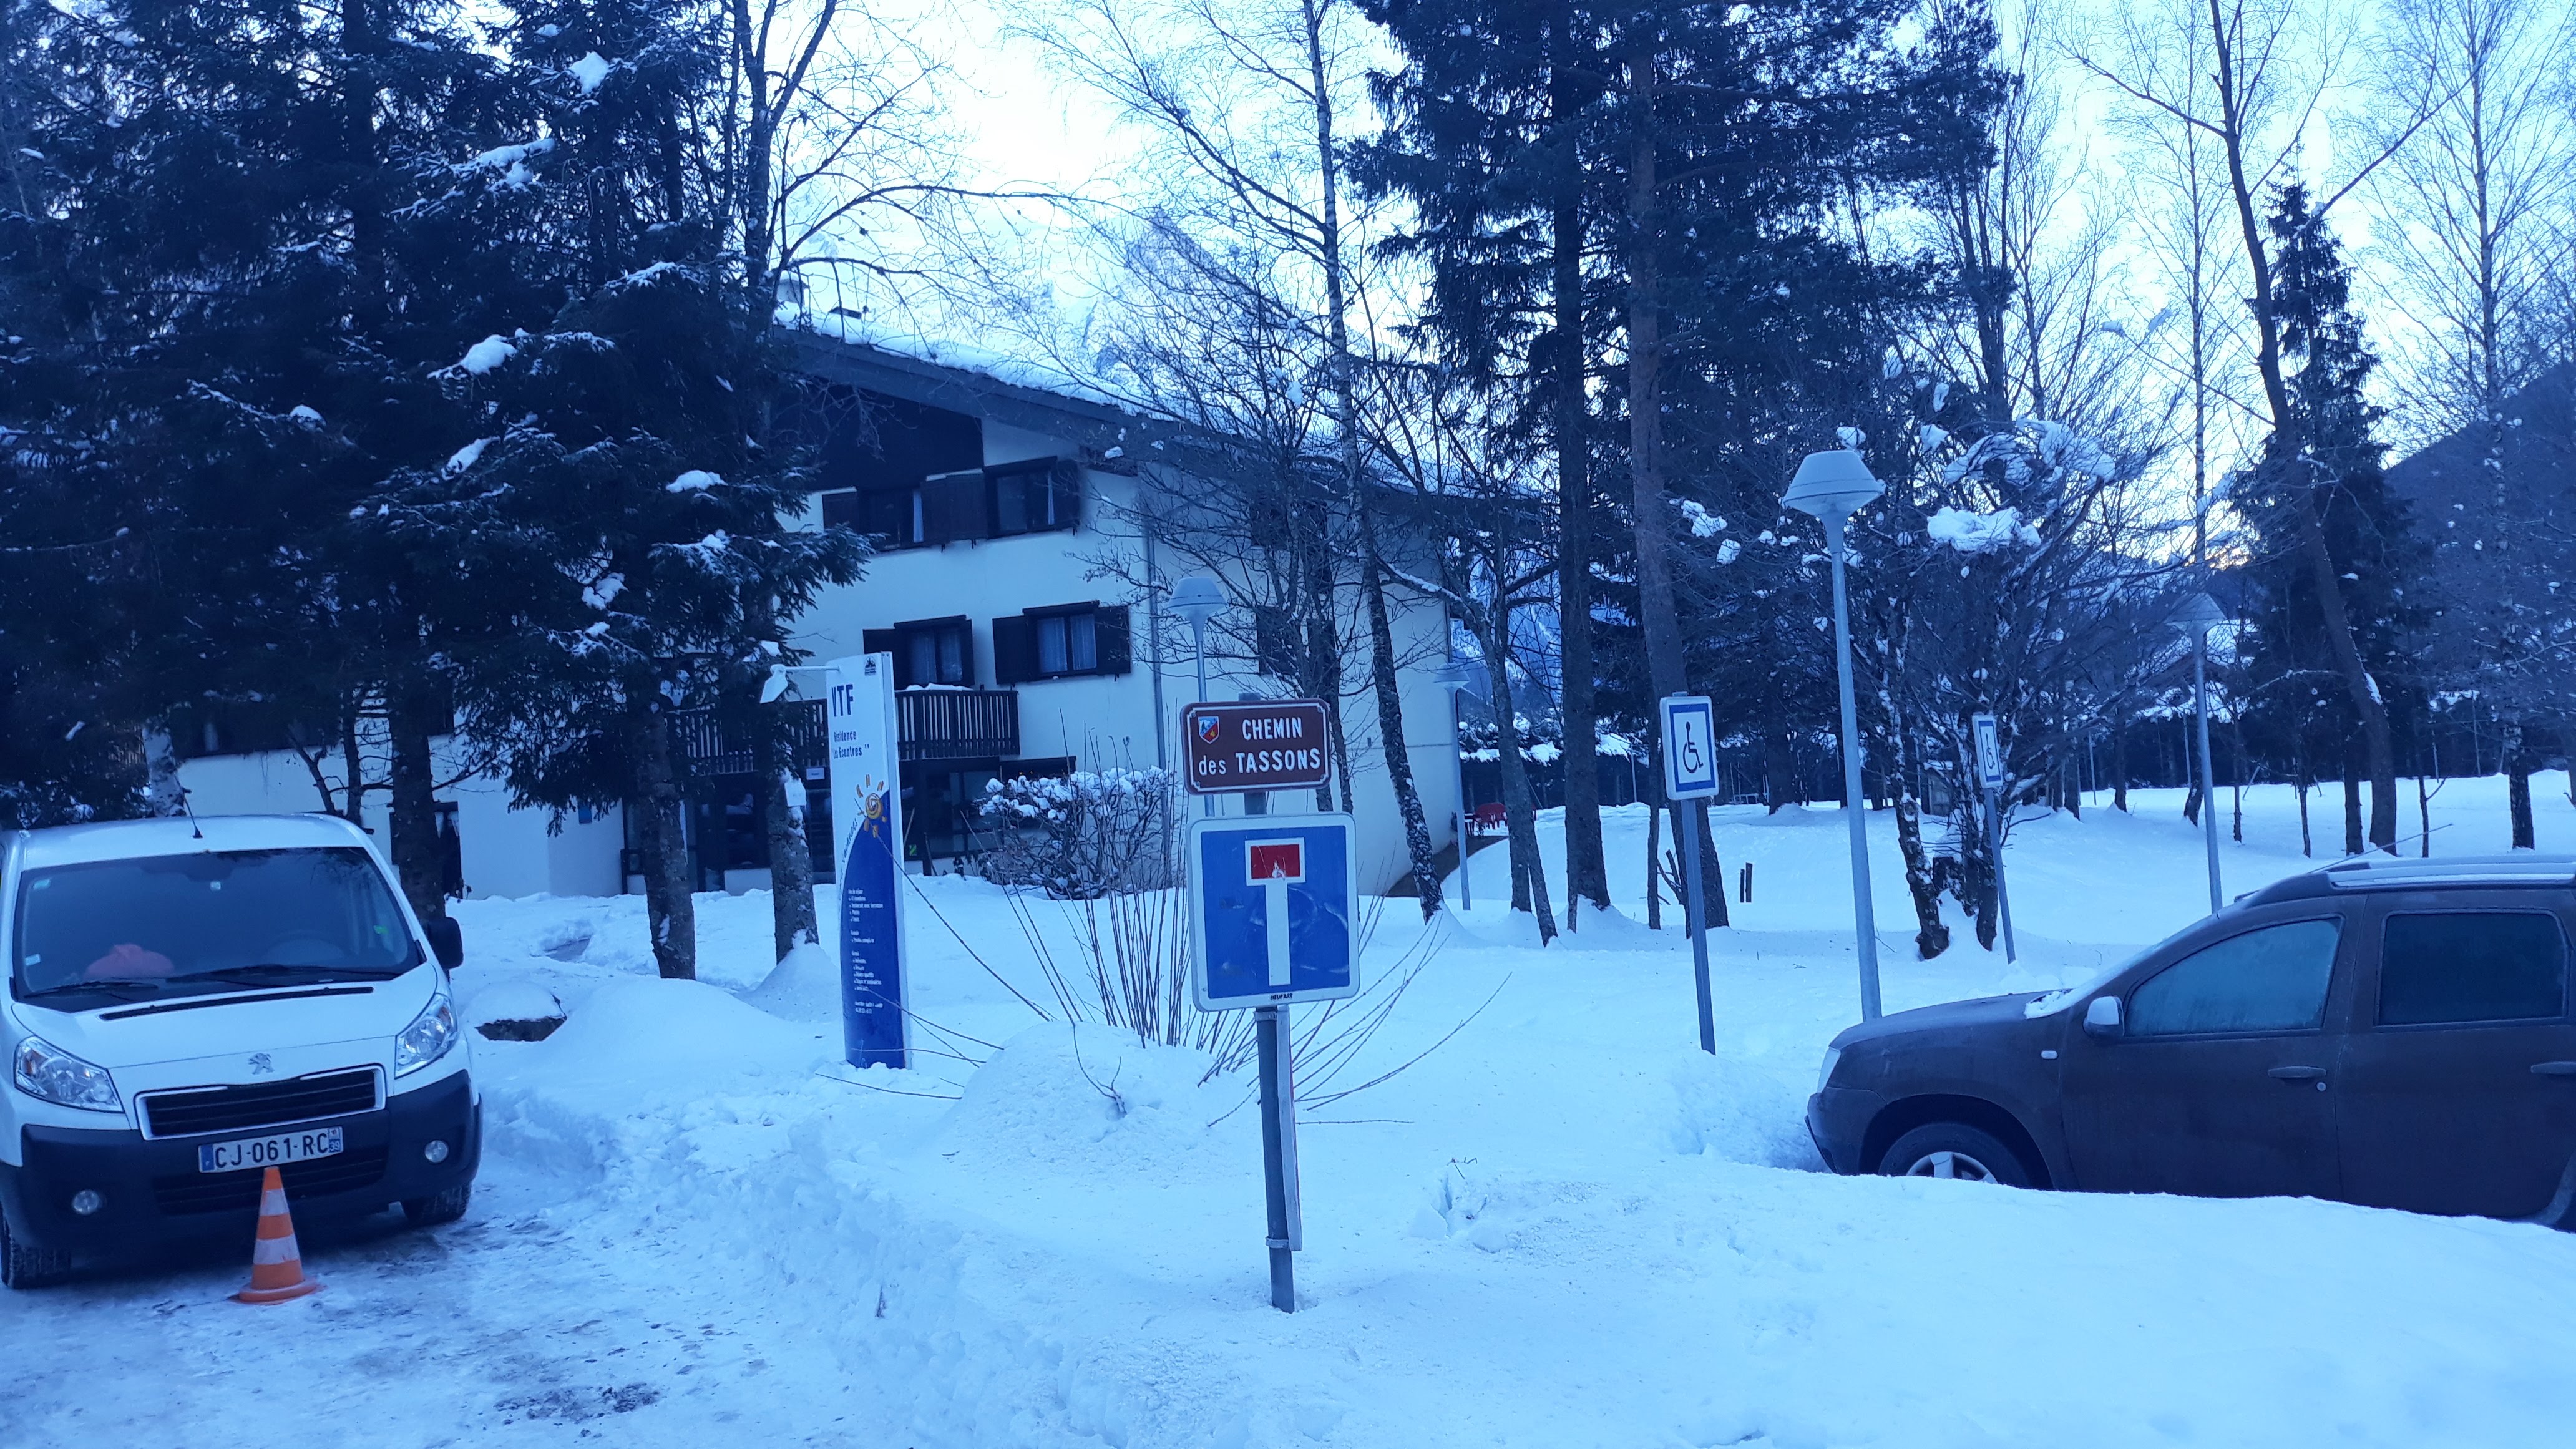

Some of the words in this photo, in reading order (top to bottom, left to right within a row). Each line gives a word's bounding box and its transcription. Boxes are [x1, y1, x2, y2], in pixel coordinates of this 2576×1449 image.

[831, 684, 854, 718] VTF
[1242, 717, 1303, 741] CHEMIN
[1198, 754, 1227, 776] des
[1235, 748, 1322, 774] TASSONS
[214, 1133, 328, 1168] CJ-061-RC
[329, 1141, 340, 1151] 39
